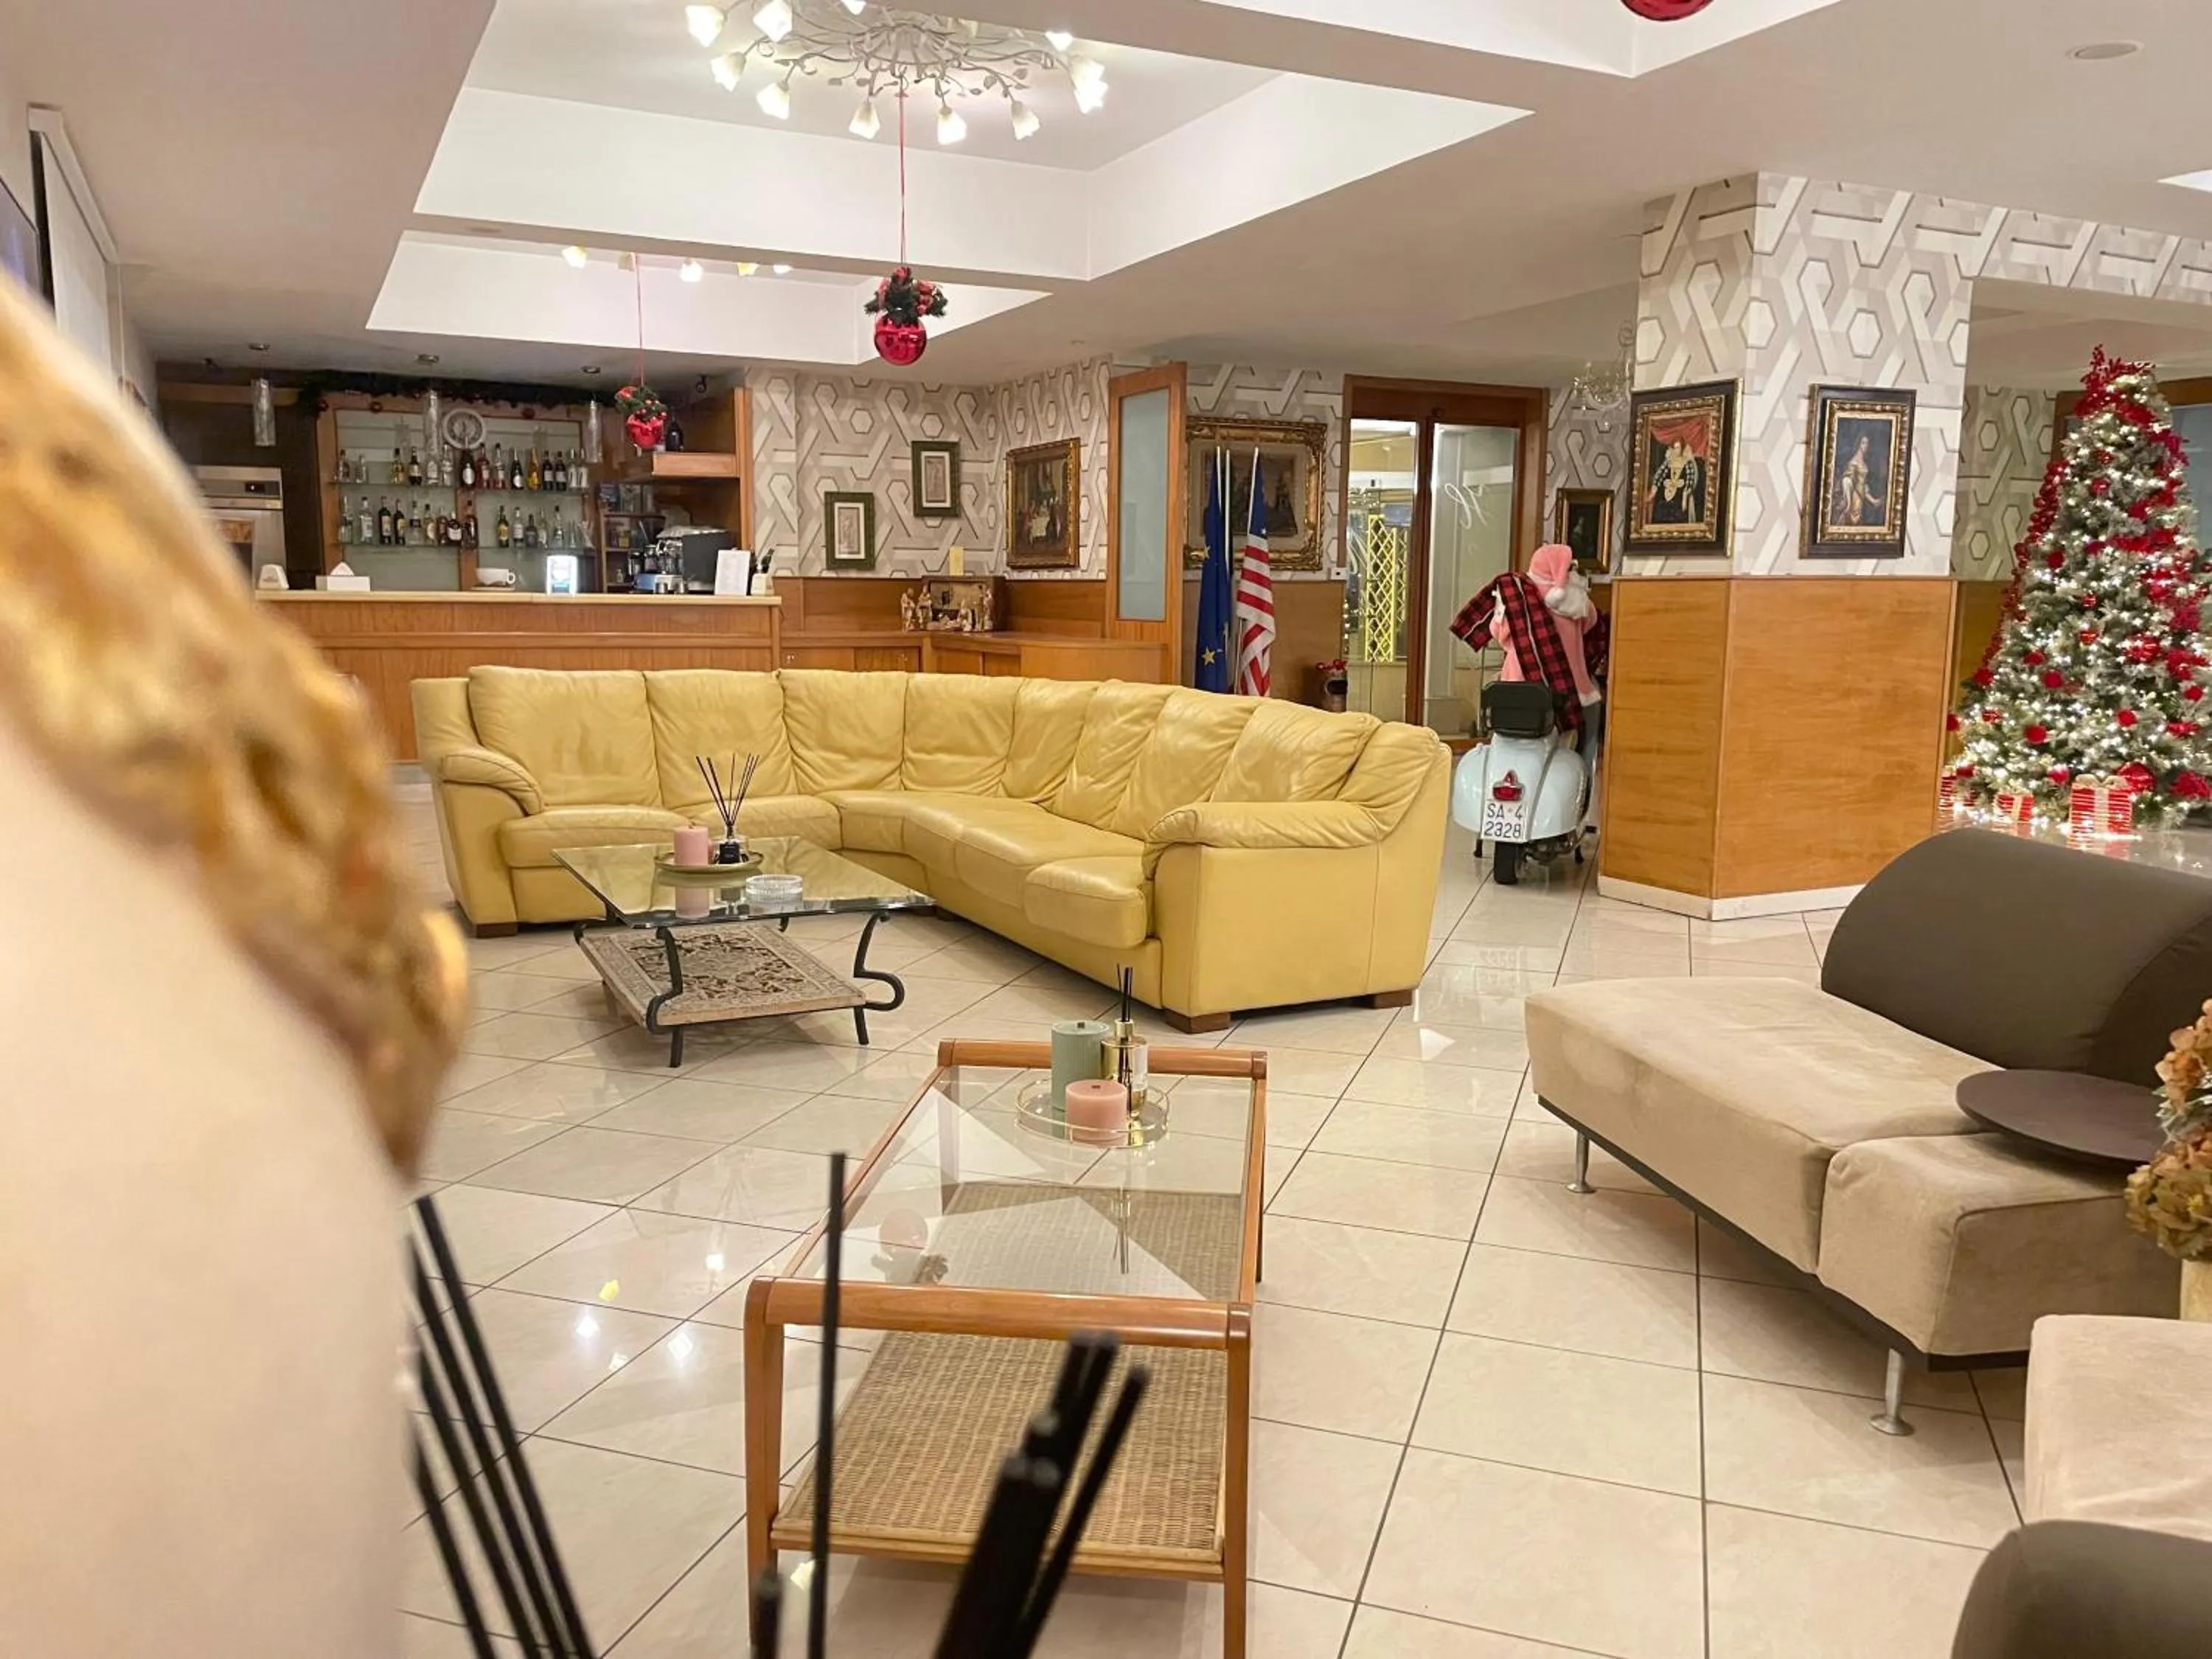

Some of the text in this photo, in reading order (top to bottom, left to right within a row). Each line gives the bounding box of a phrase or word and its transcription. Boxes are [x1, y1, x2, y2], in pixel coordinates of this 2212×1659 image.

[1486, 803, 1523, 820] SA 4
[1484, 821, 1521, 838] 2328
